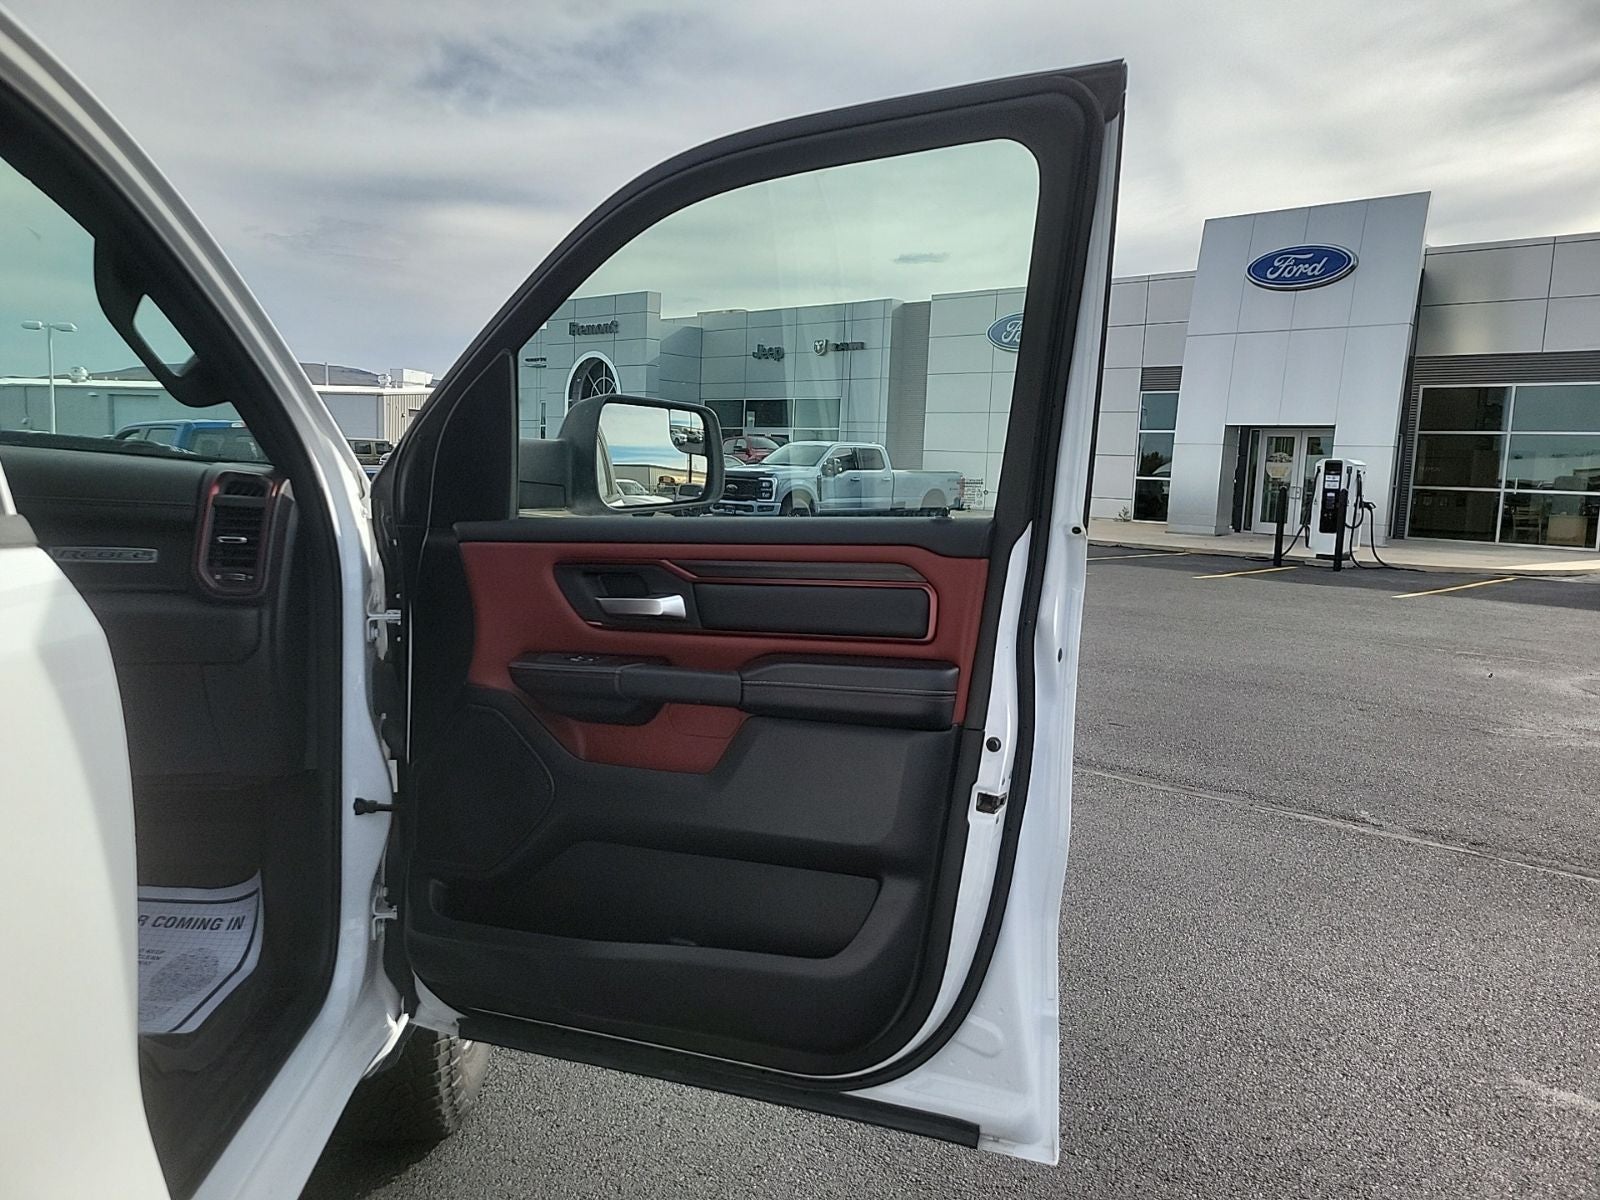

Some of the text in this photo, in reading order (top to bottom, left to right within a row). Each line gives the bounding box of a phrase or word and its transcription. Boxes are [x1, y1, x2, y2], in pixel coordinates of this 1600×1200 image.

[1266, 252, 1329, 279] Ford
[1001, 320, 1023, 342] Fo
[752, 344, 784, 361] Jeep
[151, 915, 222, 931] COMING
[225, 915, 247, 931] IN
